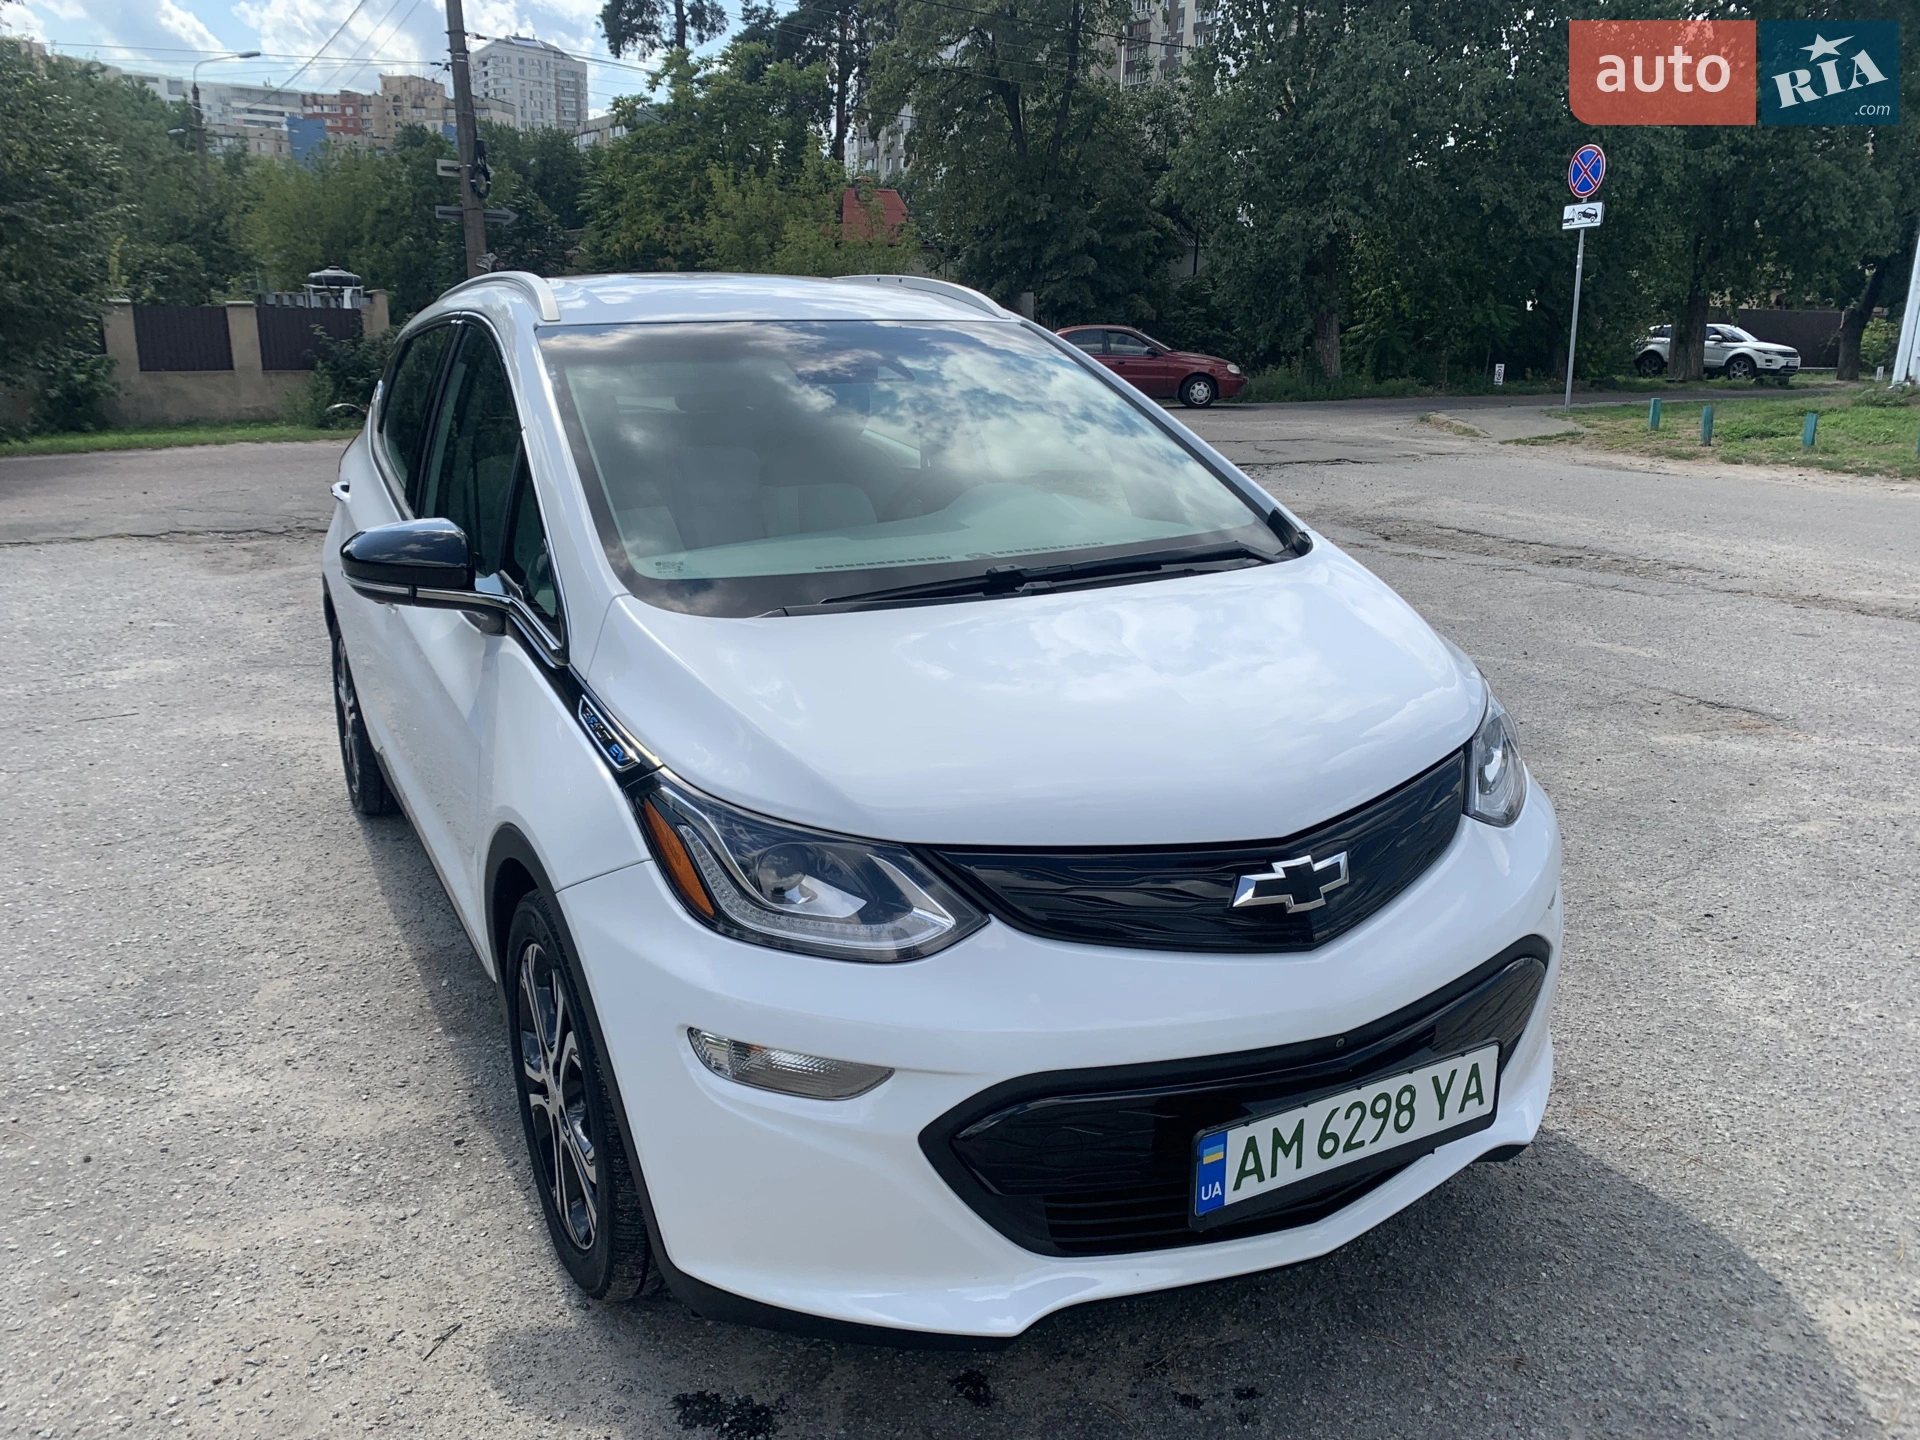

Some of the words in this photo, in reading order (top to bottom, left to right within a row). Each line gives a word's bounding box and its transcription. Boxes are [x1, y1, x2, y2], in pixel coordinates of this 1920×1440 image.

[609, 743, 630, 763] EV
[1232, 1118, 1306, 1192] AM
[1317, 1084, 1417, 1160] 6298
[1431, 1062, 1485, 1121] YA
[1201, 1181, 1223, 1201] UA
